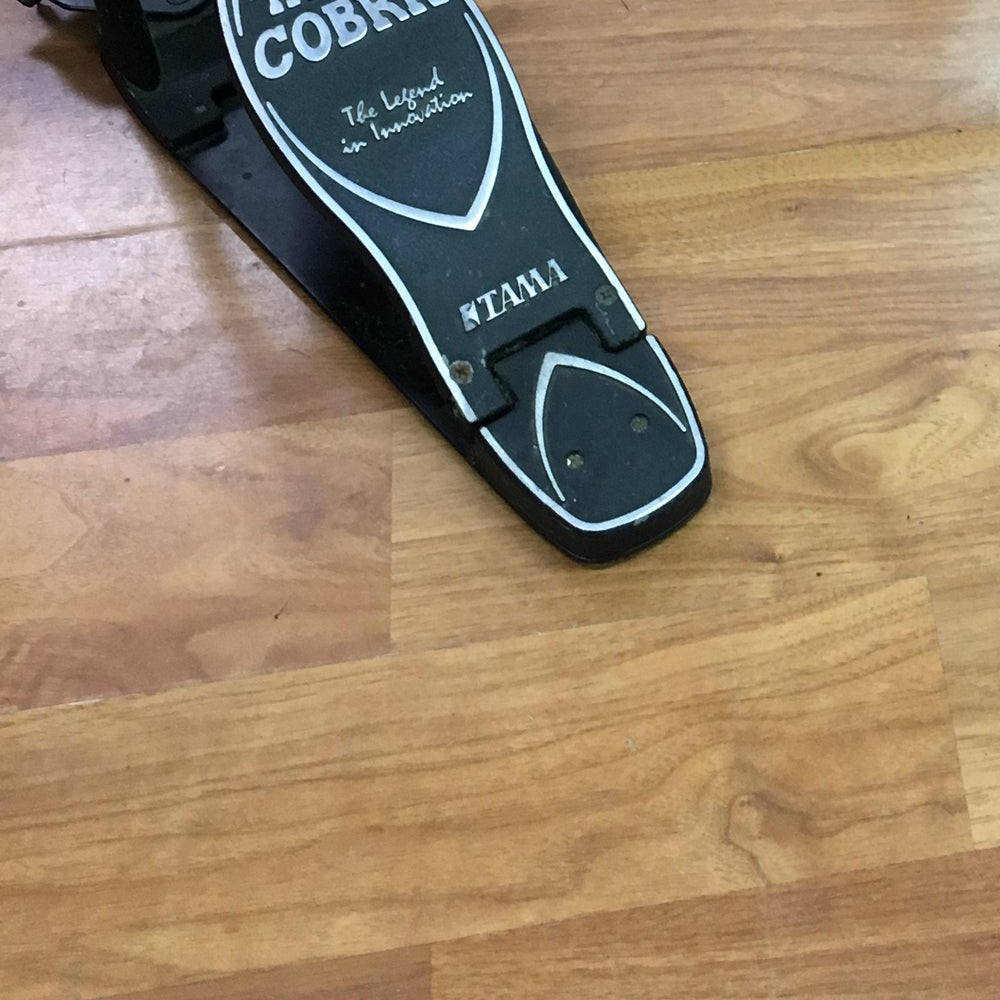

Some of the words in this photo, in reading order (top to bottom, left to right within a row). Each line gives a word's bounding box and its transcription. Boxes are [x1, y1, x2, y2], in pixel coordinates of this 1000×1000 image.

[341, 100, 378, 127] The
[380, 66, 444, 111] Legend
[341, 138, 367, 154] in
[370, 91, 473, 140] Innovation
